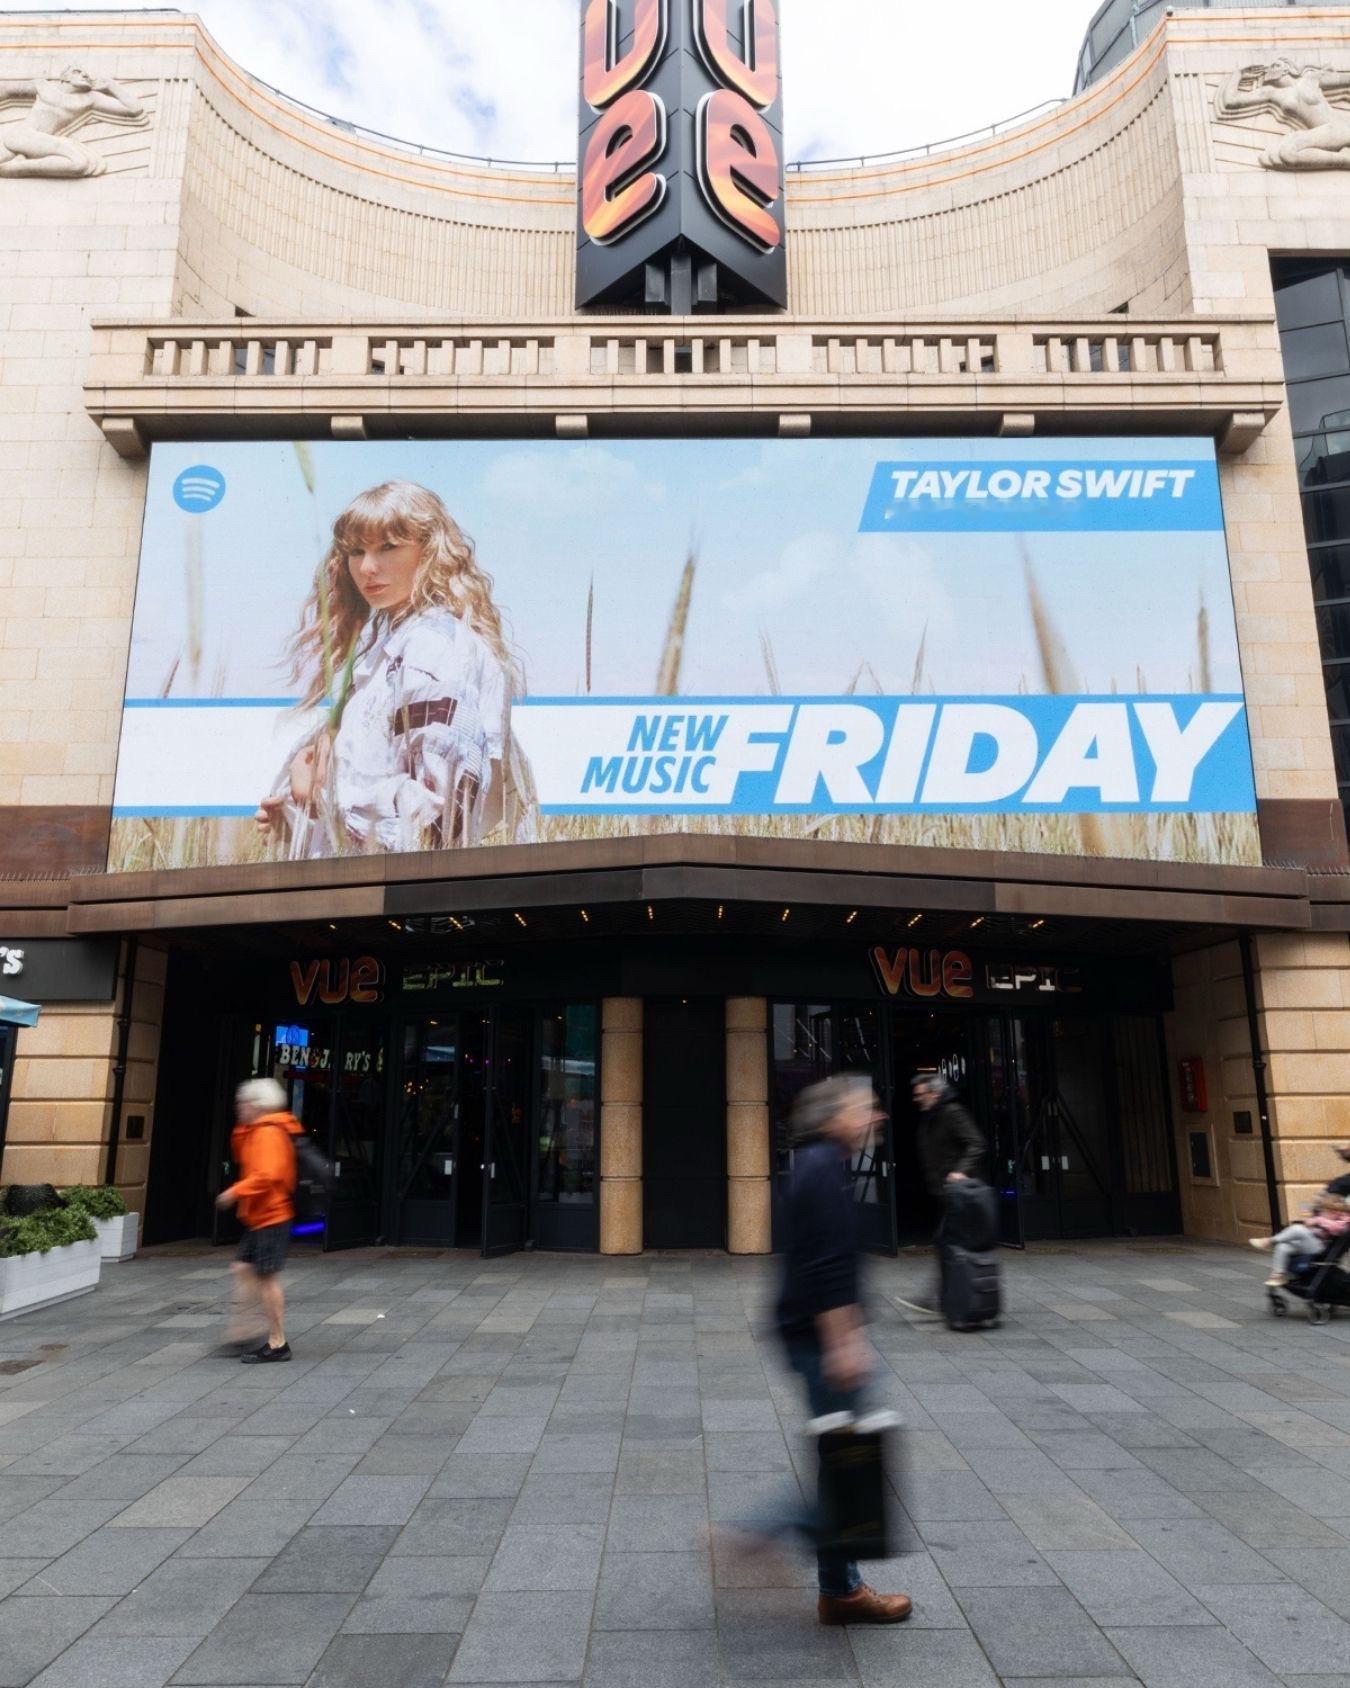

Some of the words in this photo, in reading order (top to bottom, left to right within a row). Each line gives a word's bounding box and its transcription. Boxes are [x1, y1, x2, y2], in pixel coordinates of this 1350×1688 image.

[891, 469, 1050, 499] TAYLOR
[1056, 469, 1195, 499] SWIFT
[626, 714, 730, 752] NEW
[706, 702, 1244, 804] FRIDAY
[579, 755, 717, 794] MUSIC
[279, 1043, 310, 1066] BEN
